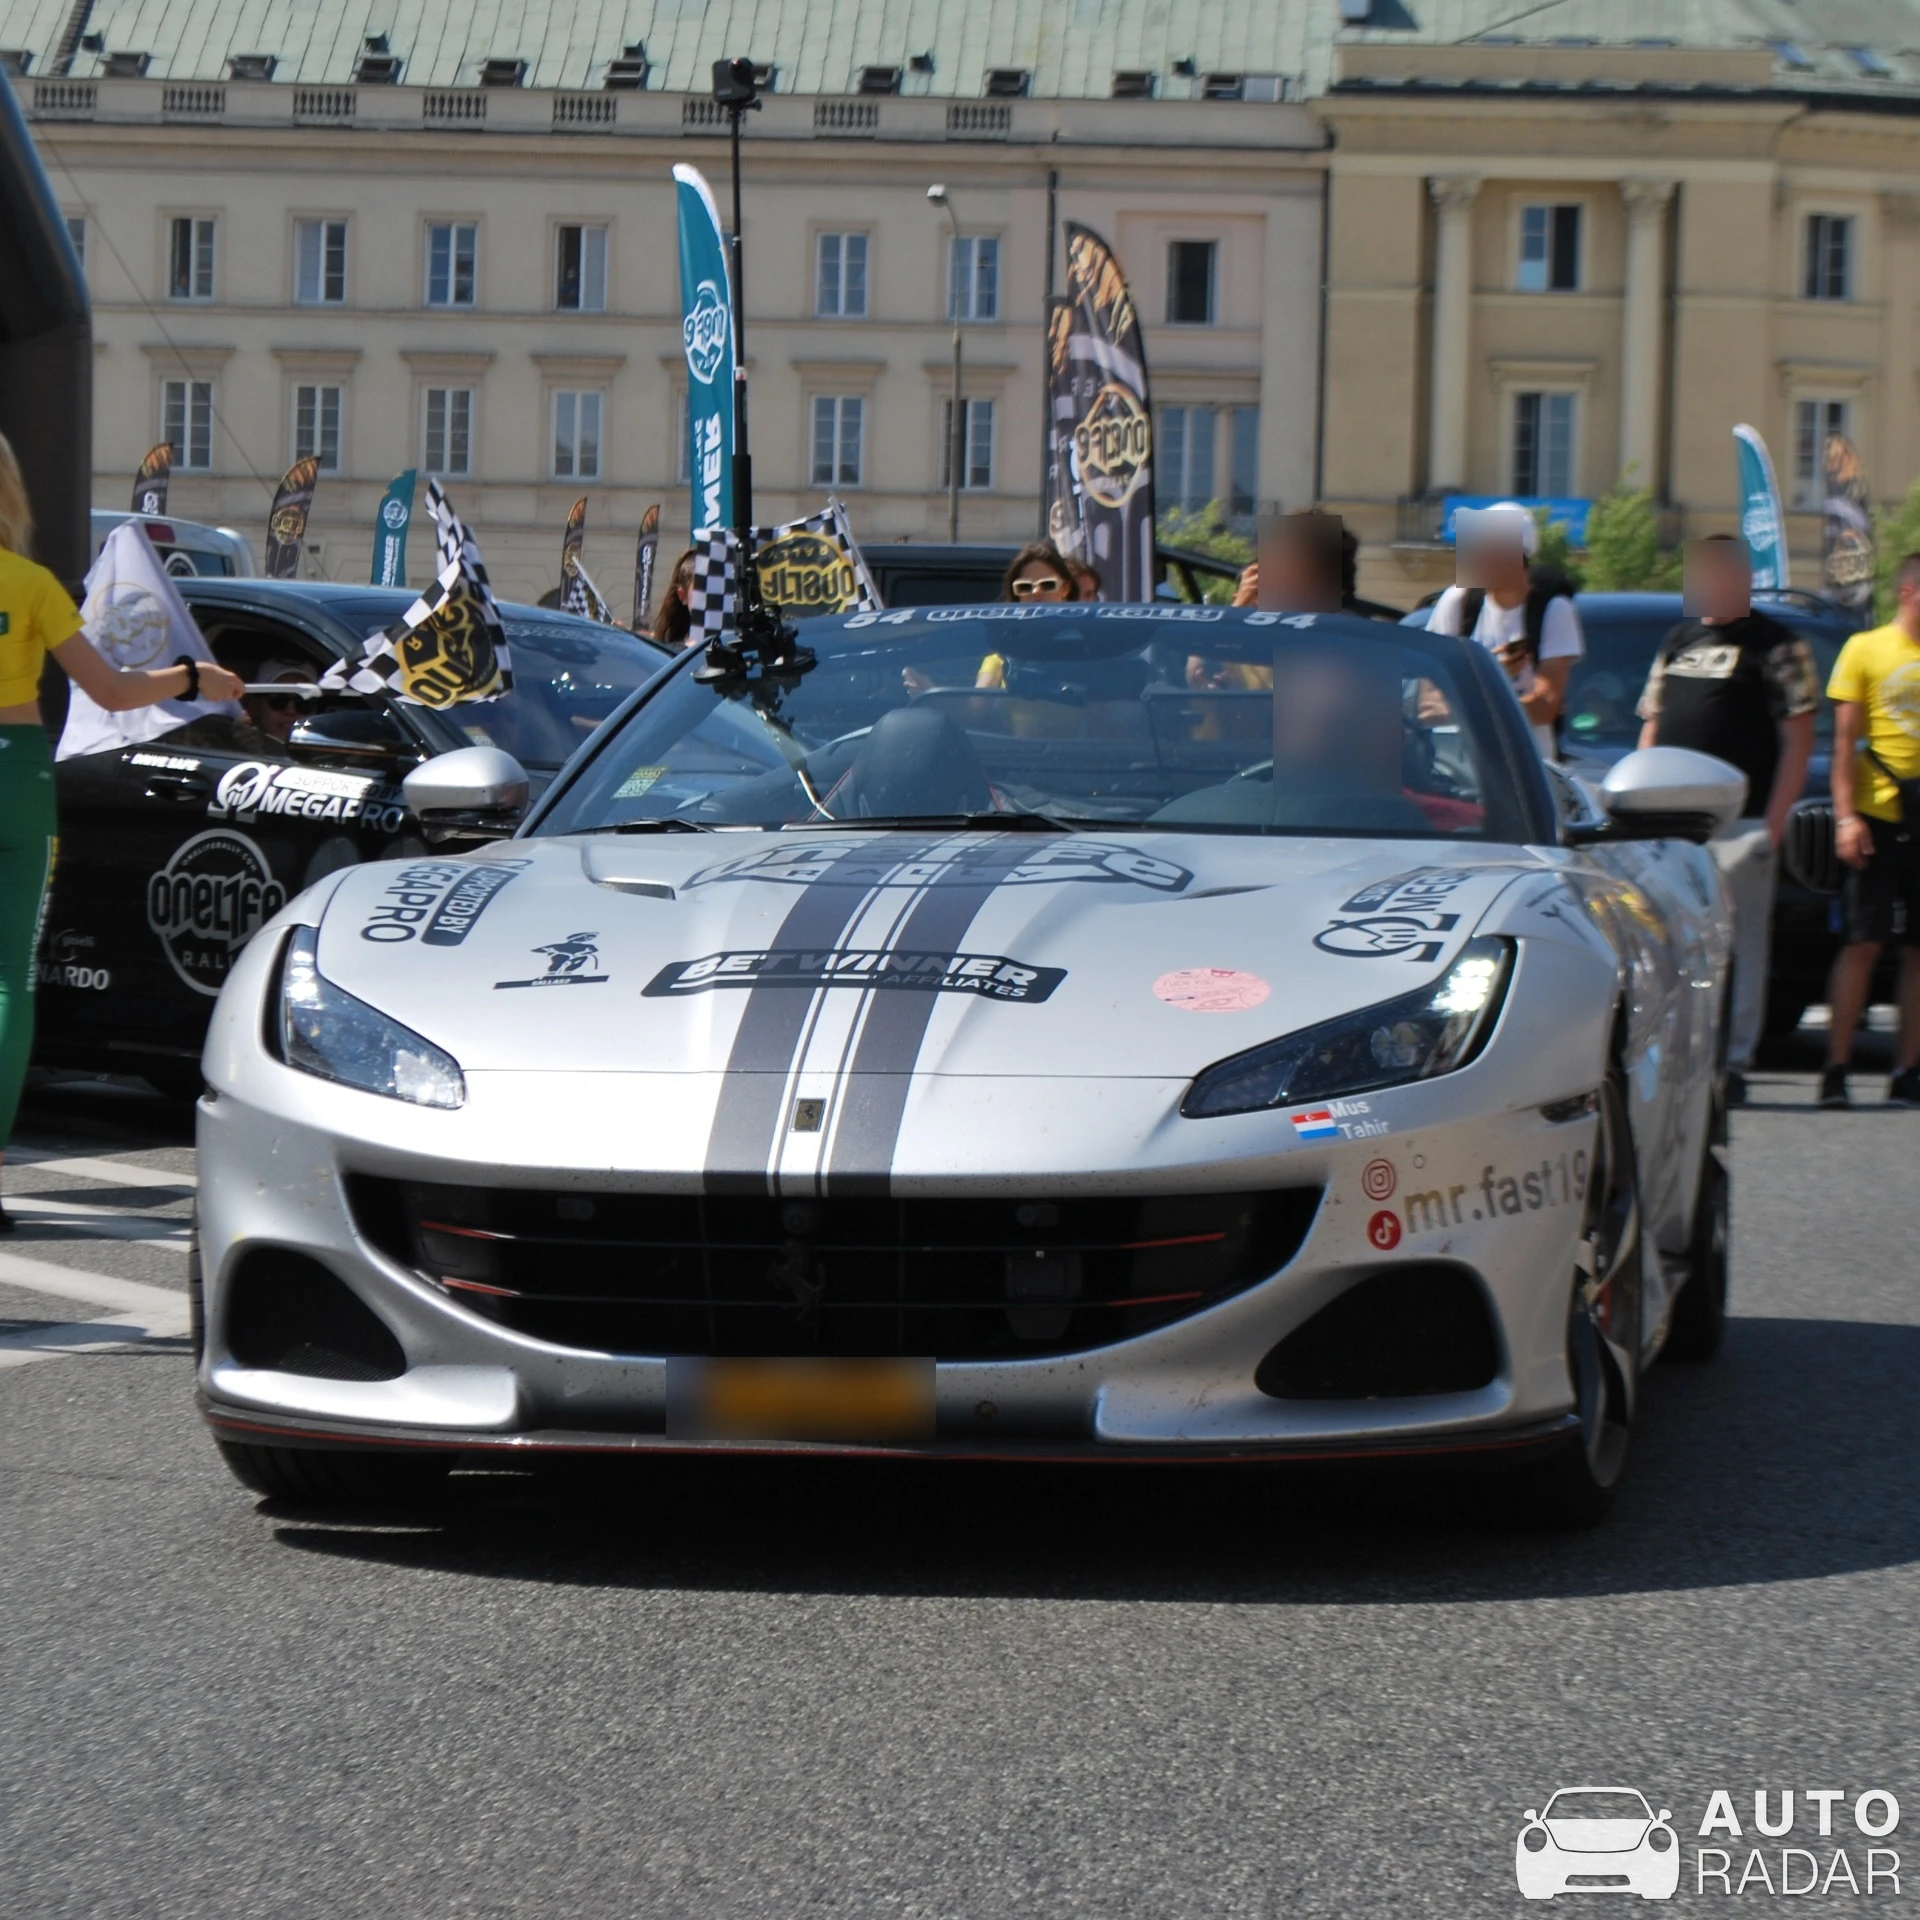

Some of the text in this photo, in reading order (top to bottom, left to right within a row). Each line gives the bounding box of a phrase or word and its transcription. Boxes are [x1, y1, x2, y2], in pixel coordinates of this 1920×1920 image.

[843, 608, 916, 629] 54
[1243, 611, 1319, 630] 54
[434, 914, 471, 934] BY
[183, 950, 232, 969] RAL
[679, 953, 1038, 987] BETWINNER
[37, 964, 109, 990] NARDO
[883, 974, 1028, 998] AFFILIATES
[1327, 1101, 1371, 1119] Mus
[1339, 1119, 1389, 1140] Tahir
